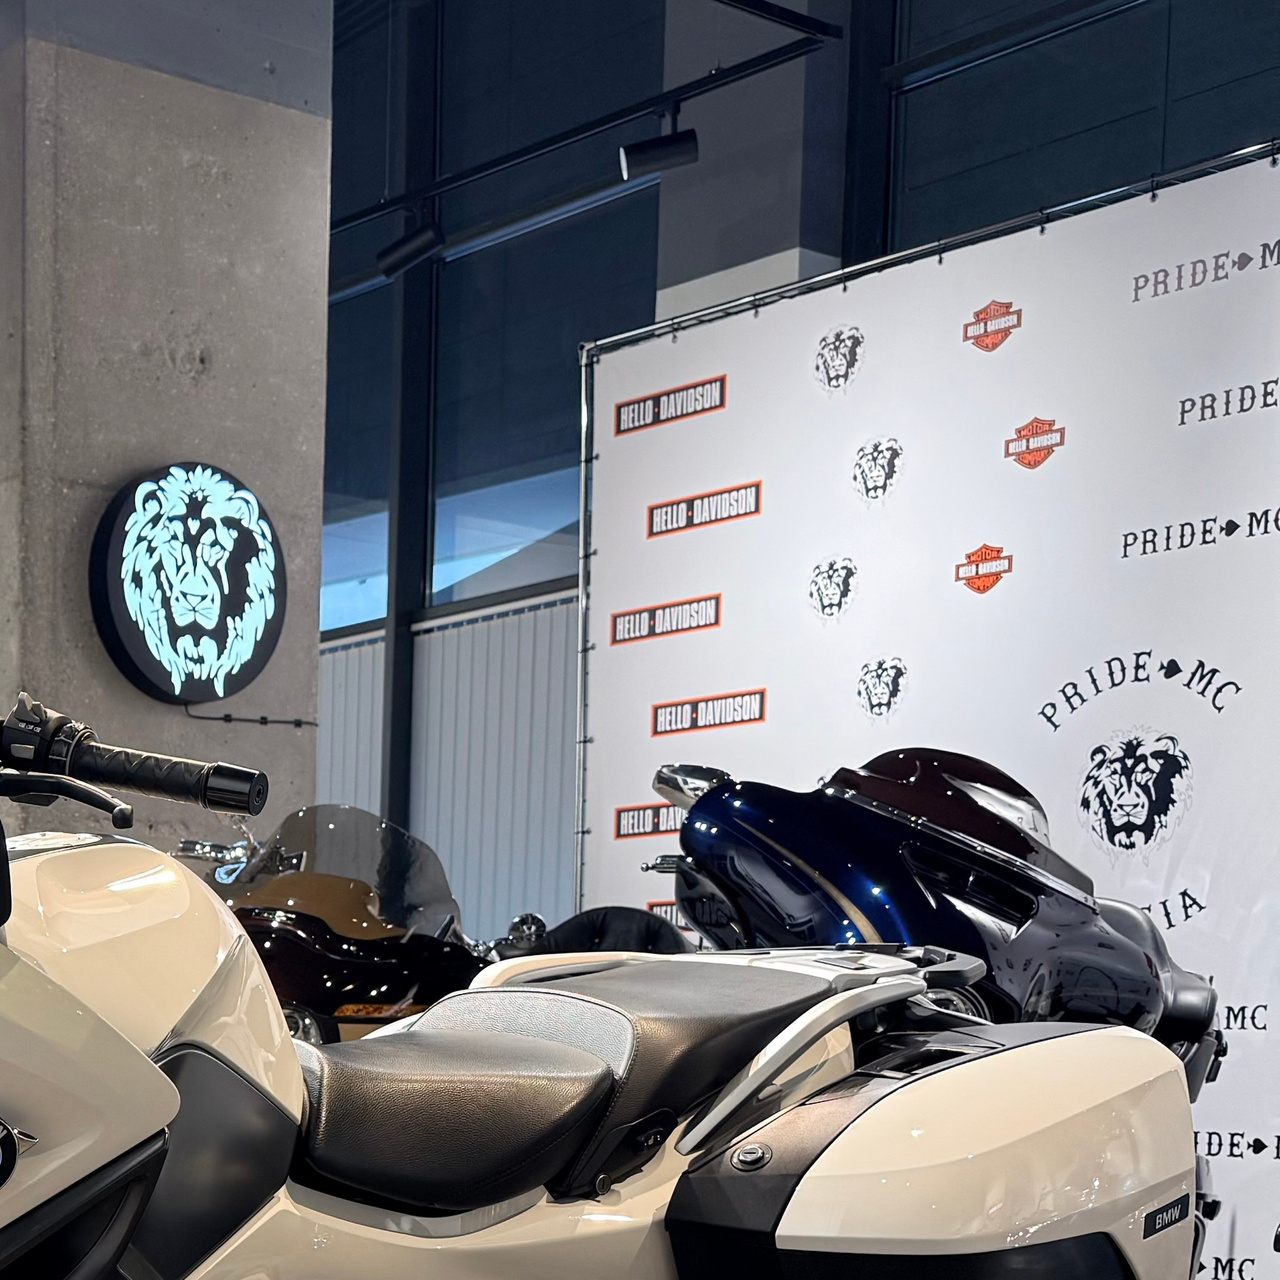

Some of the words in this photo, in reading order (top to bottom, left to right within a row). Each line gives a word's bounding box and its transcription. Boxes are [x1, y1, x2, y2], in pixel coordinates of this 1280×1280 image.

[1132, 250, 1230, 303] PRIDE
[620, 400, 654, 431] HELLO
[659, 380, 721, 421] DAVIDSON
[1178, 377, 1280, 426] PRIDE
[652, 502, 688, 534] HELLO
[693, 486, 756, 525] DAVIDSON
[1121, 515, 1218, 559] PRIDE
[616, 612, 650, 641] HELLO
[655, 599, 717, 634] DAVIDSON
[1038, 649, 1153, 732] PRIDE
[1182, 659, 1243, 714] MC
[657, 703, 692, 733] HELLO
[697, 693, 761, 727] DAVIDSON
[620, 808, 653, 836] HELLO
[1223, 1004, 1268, 1031] MC
[1193, 1131, 1245, 1160] IDE
[1155, 1204, 1182, 1230] BMW
